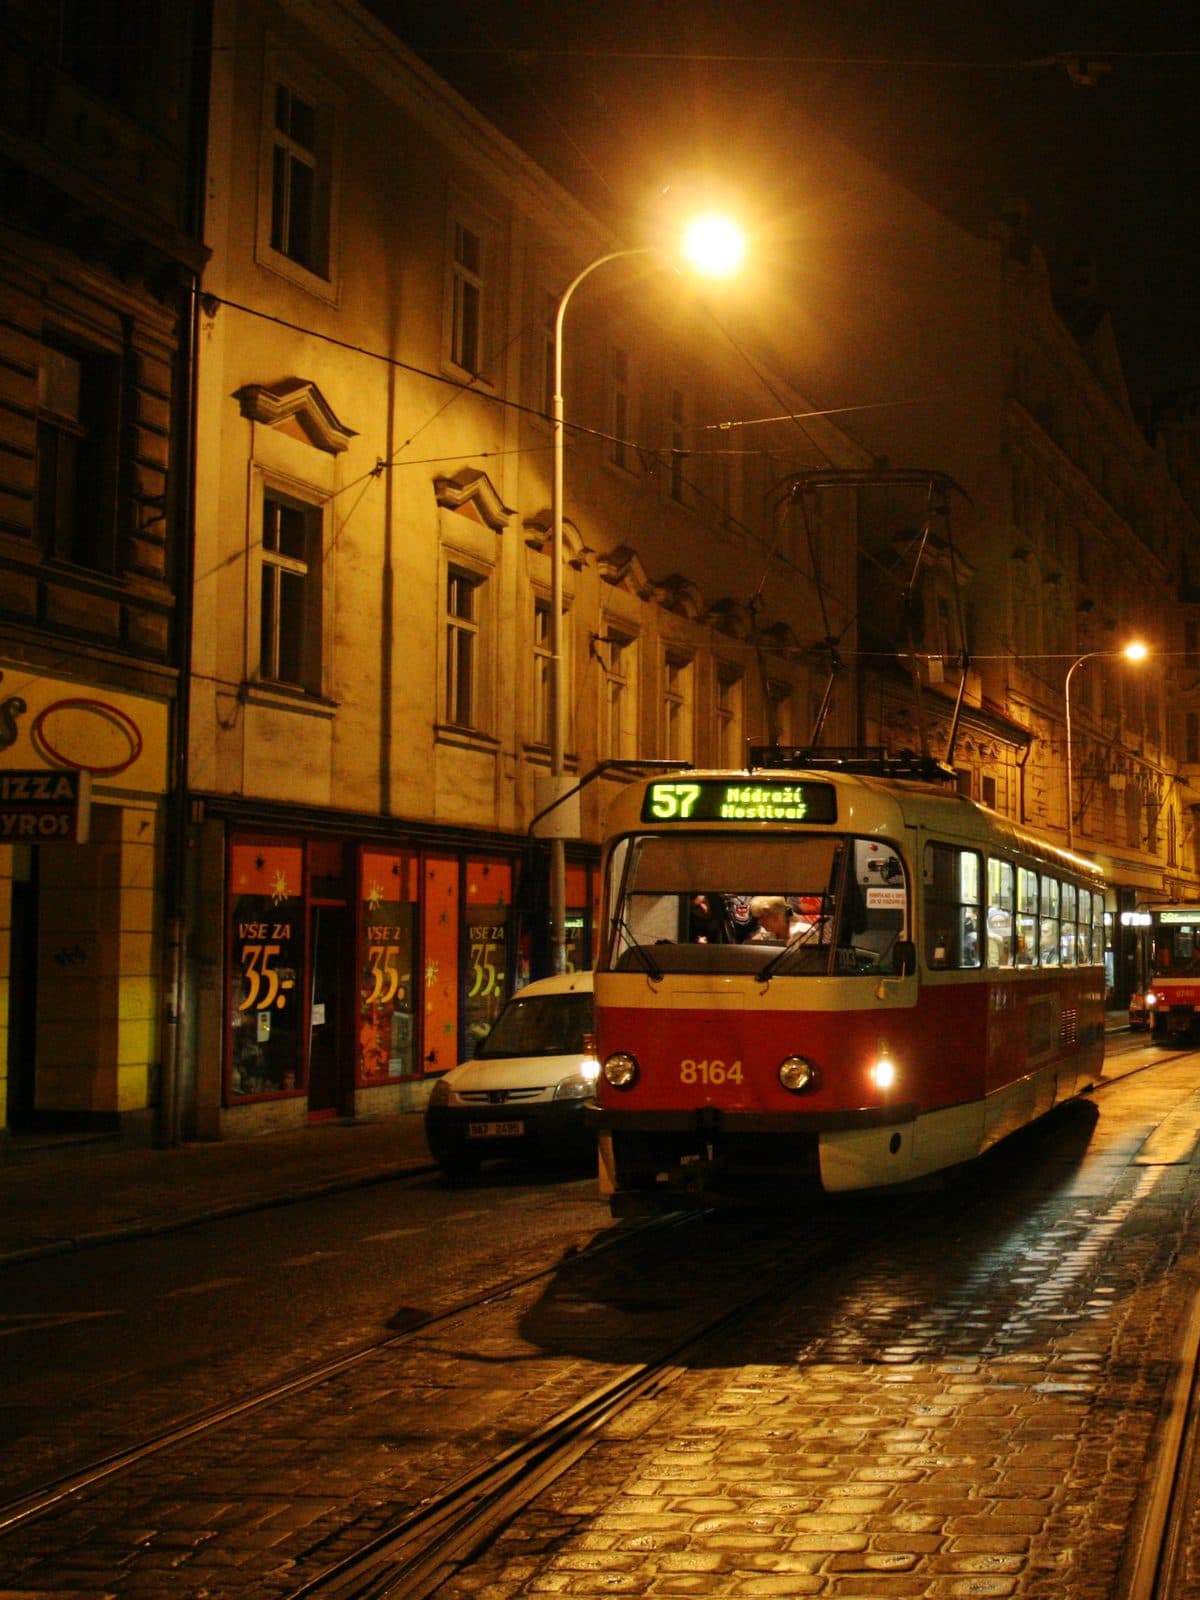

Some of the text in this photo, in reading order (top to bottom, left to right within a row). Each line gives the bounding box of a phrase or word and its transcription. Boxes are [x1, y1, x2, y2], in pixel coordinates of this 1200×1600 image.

[0, 776, 73, 799] IZZA
[727, 787, 802, 803] Nádraží
[652, 784, 699, 818] 57
[721, 804, 807, 819] Hostivař
[0, 813, 70, 836] YROS
[271, 923, 291, 939] ZA
[680, 1059, 744, 1085] 8164
